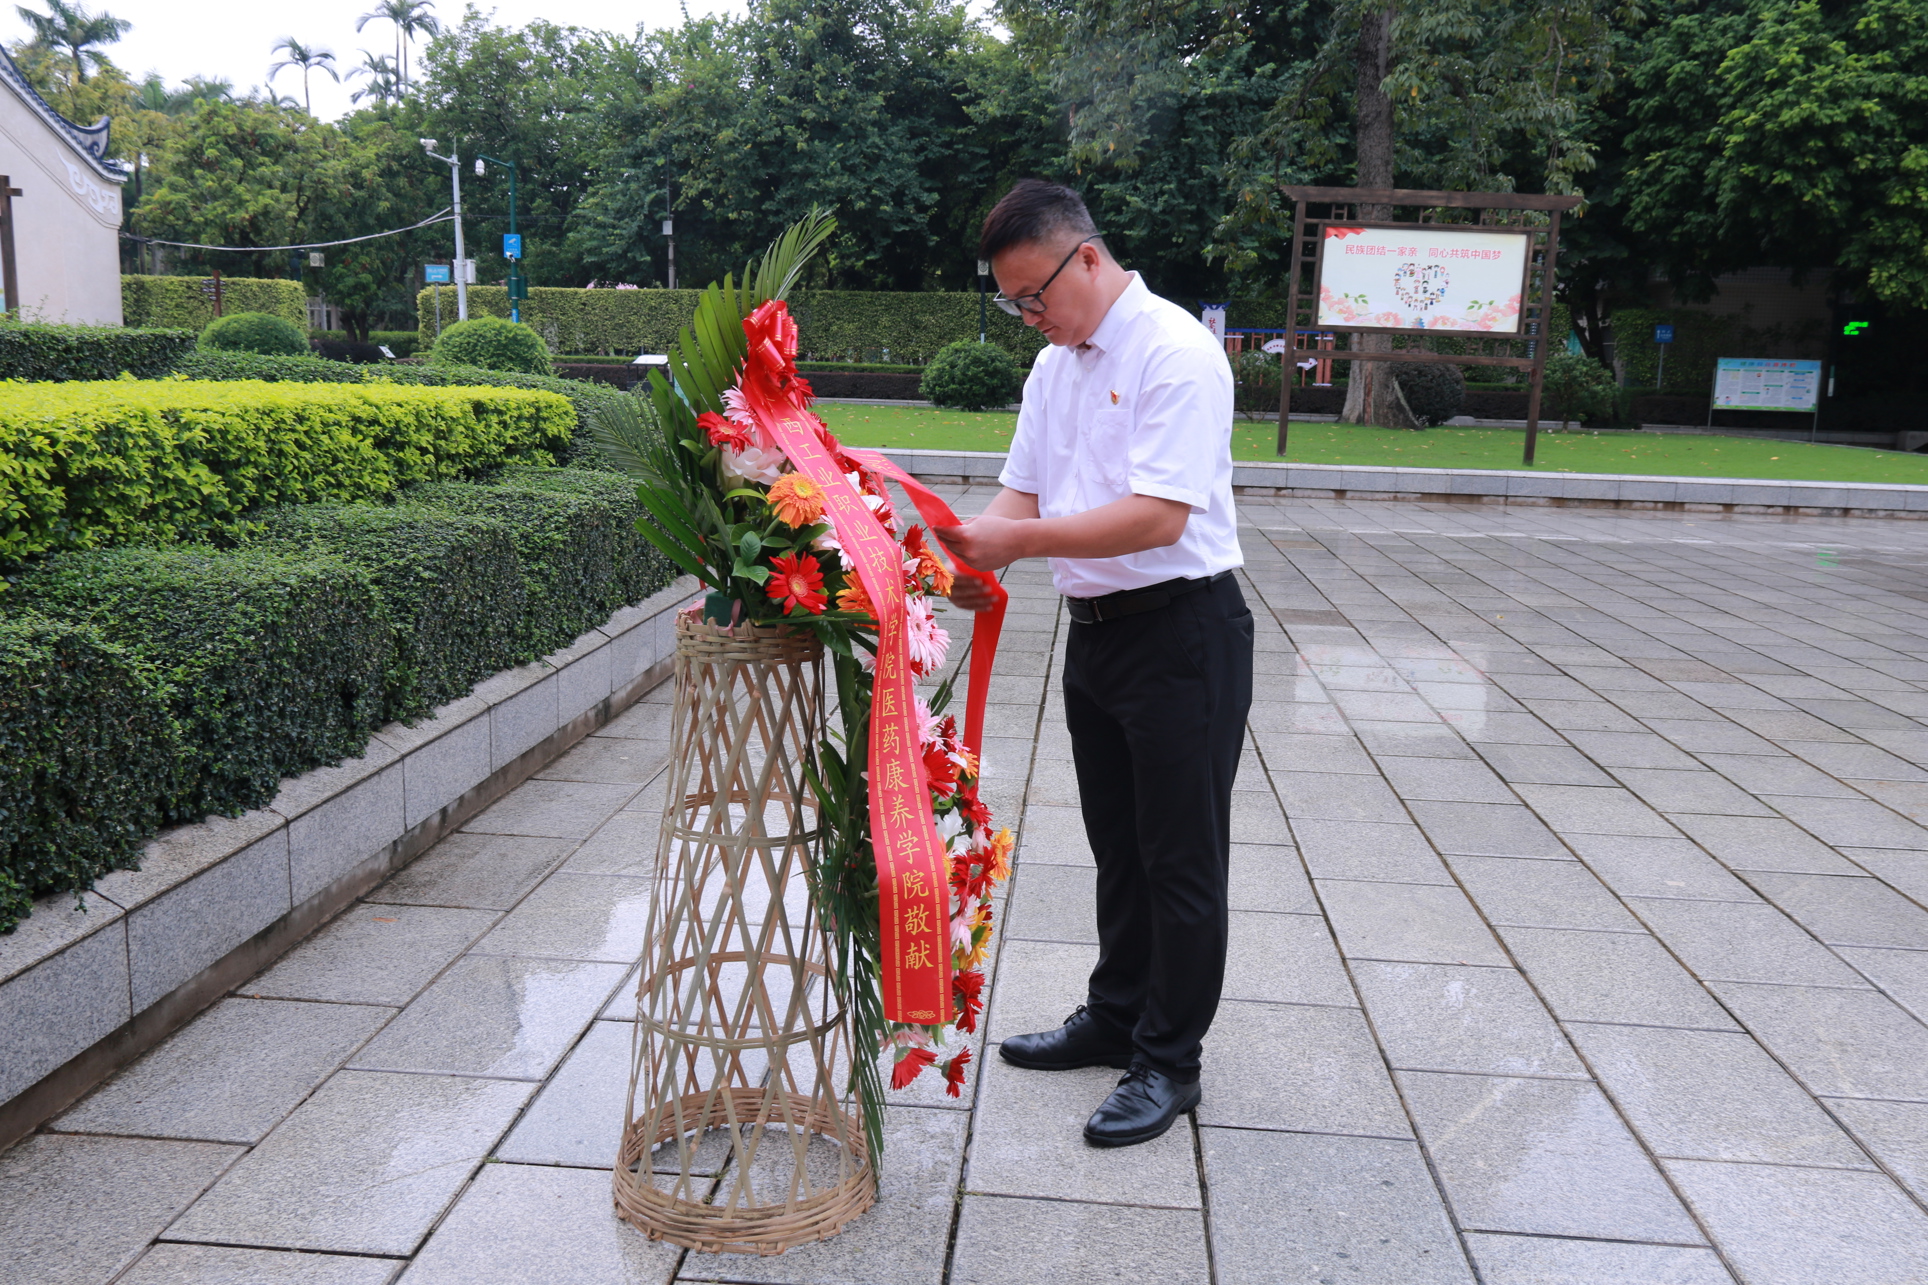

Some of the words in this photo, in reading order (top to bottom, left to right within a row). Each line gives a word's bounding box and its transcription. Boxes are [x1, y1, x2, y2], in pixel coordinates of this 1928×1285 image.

[1345, 244, 1418, 257] 民族团结一家亲
[1428, 247, 1502, 260] 同心共筑中国梦
[766, 395, 933, 970] 西工业职业技术学院医药康养学院敬献
